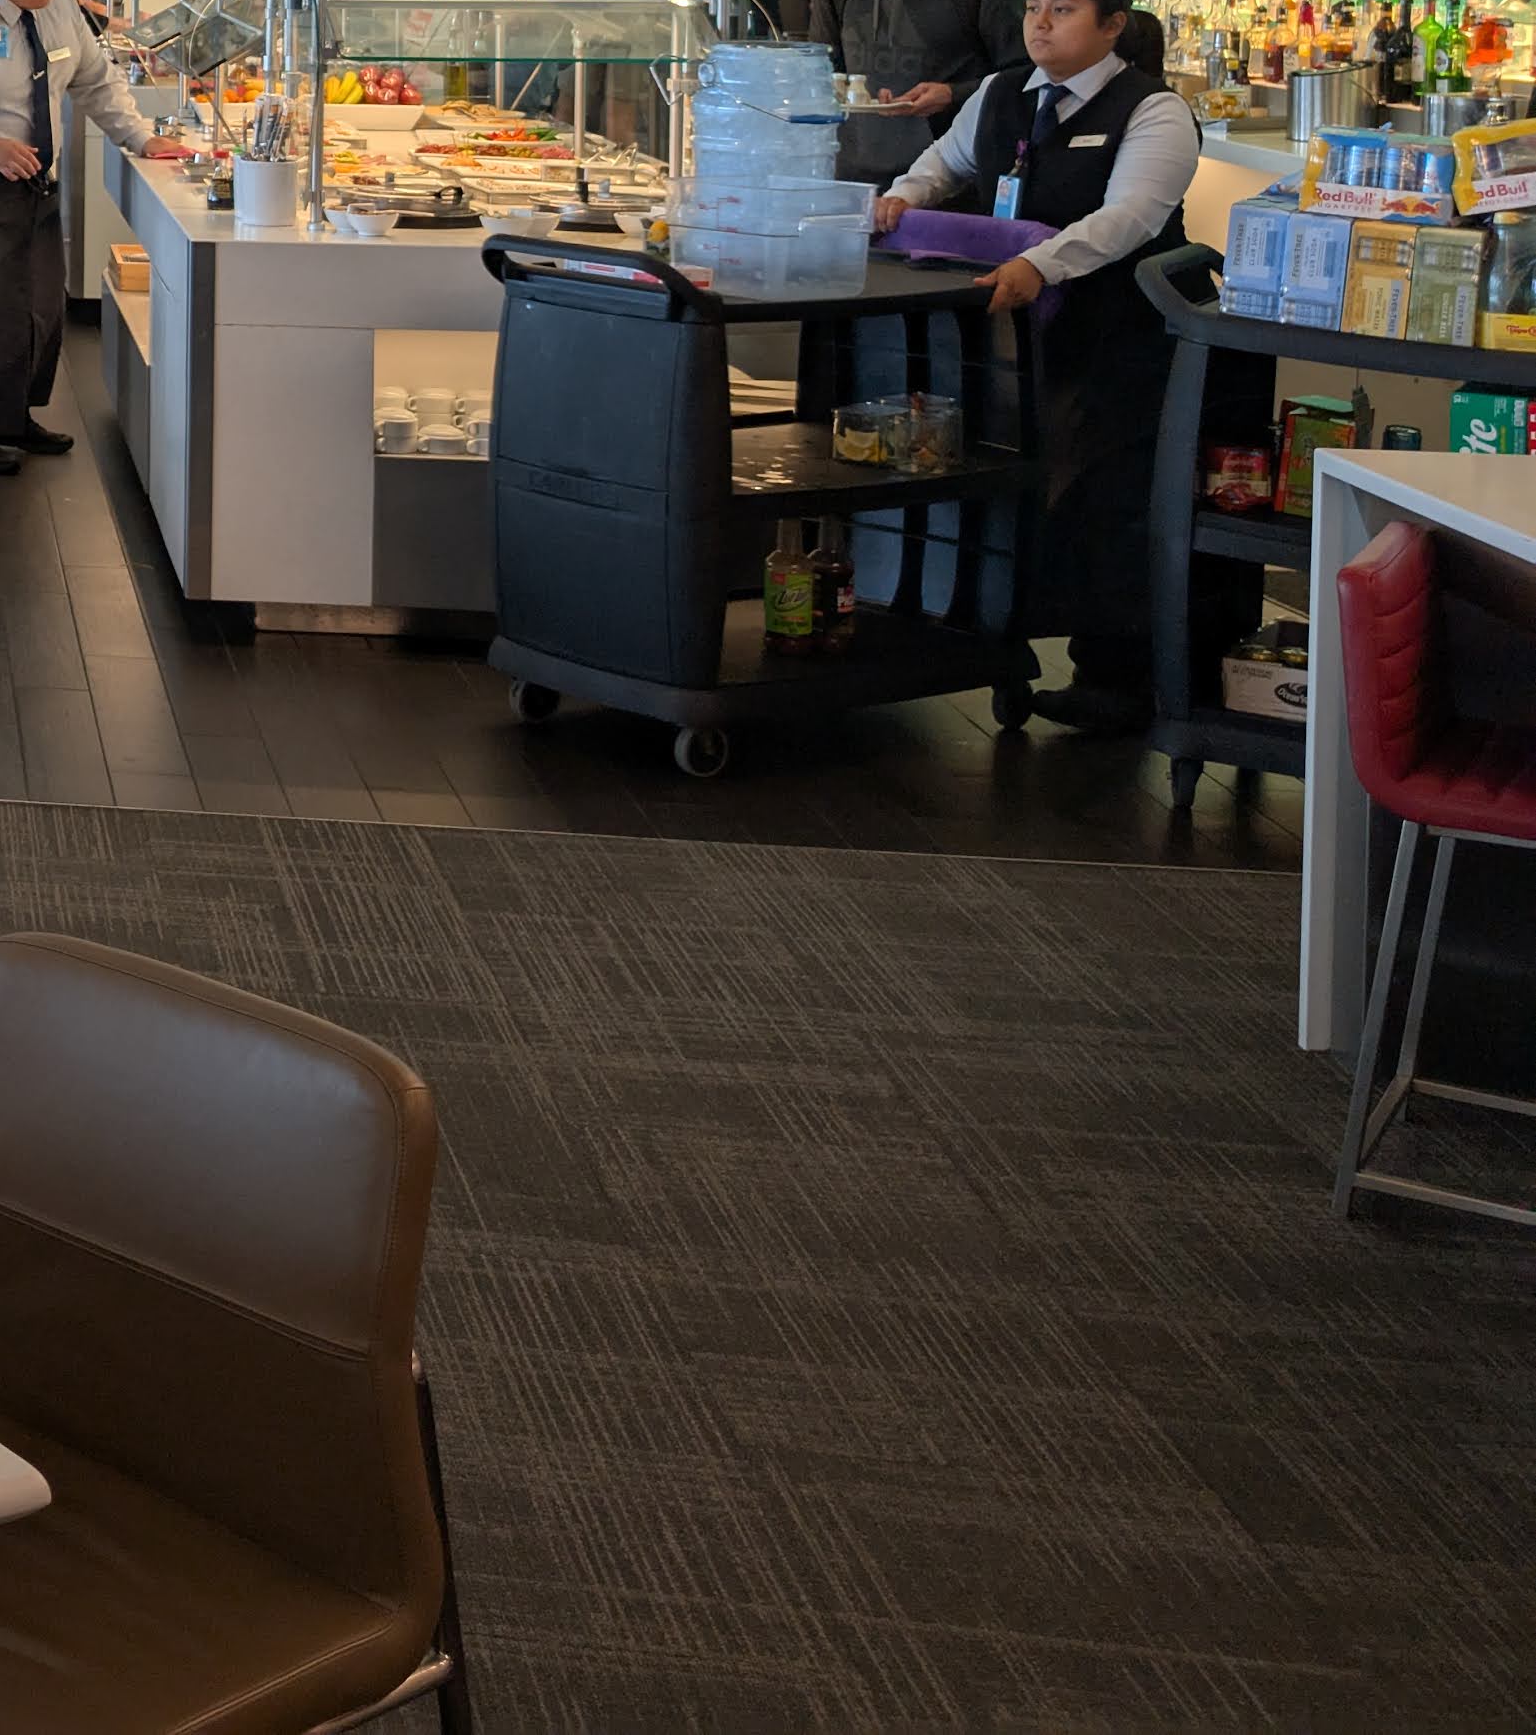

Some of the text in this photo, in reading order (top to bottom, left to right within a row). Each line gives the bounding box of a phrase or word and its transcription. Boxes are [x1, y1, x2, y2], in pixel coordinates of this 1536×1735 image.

[1315, 187, 1374, 206] Red Bull
[1497, 181, 1528, 197] Bull
